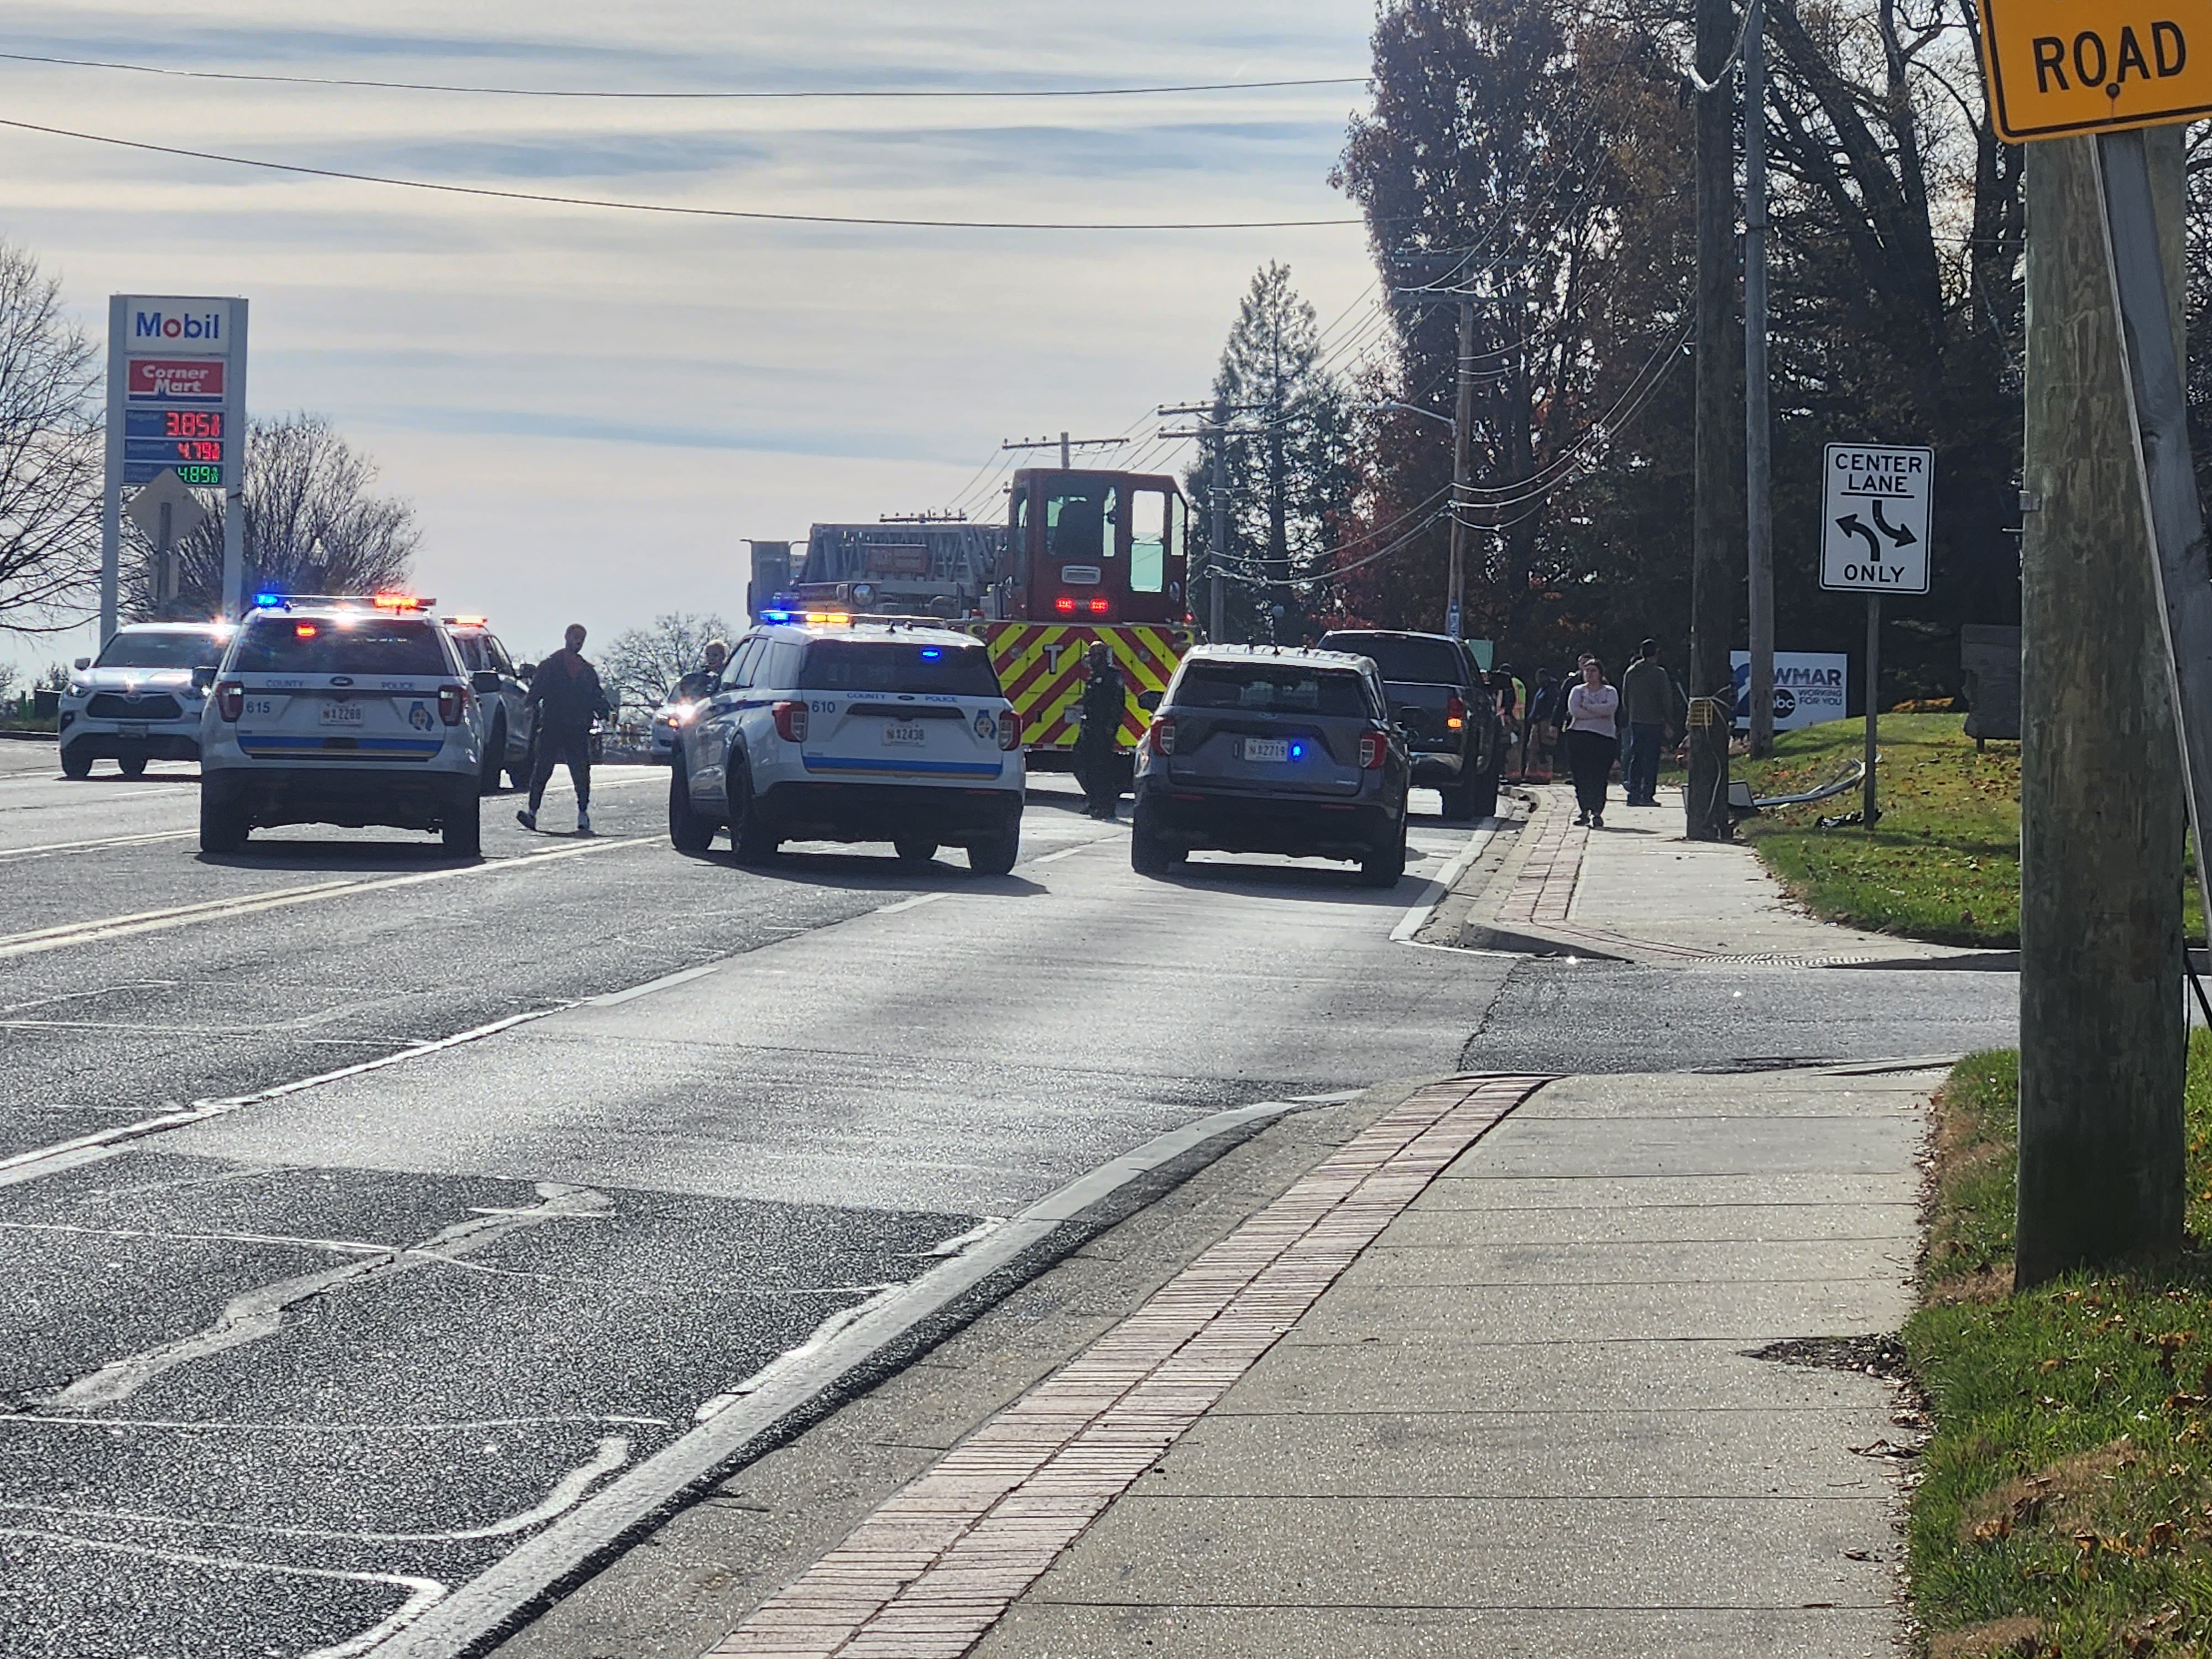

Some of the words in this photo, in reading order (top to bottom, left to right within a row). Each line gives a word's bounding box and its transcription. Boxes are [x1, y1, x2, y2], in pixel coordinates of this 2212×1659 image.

[2033, 21, 2187, 93] ROAD
[136, 311, 219, 339] Mobil
[142, 364, 209, 379] Corner
[155, 378, 202, 393] Mart
[1835, 453, 1922, 473] CENTER
[1848, 474, 1908, 493] LANE
[1844, 564, 1906, 583] ONLY
[266, 680, 304, 688] COUNTY
[380, 681, 414, 690] POLICE
[1773, 668, 1841, 686] WMAR
[1798, 688, 1842, 697] WORKING
[247, 701, 270, 713] 615
[812, 701, 836, 713] 610
